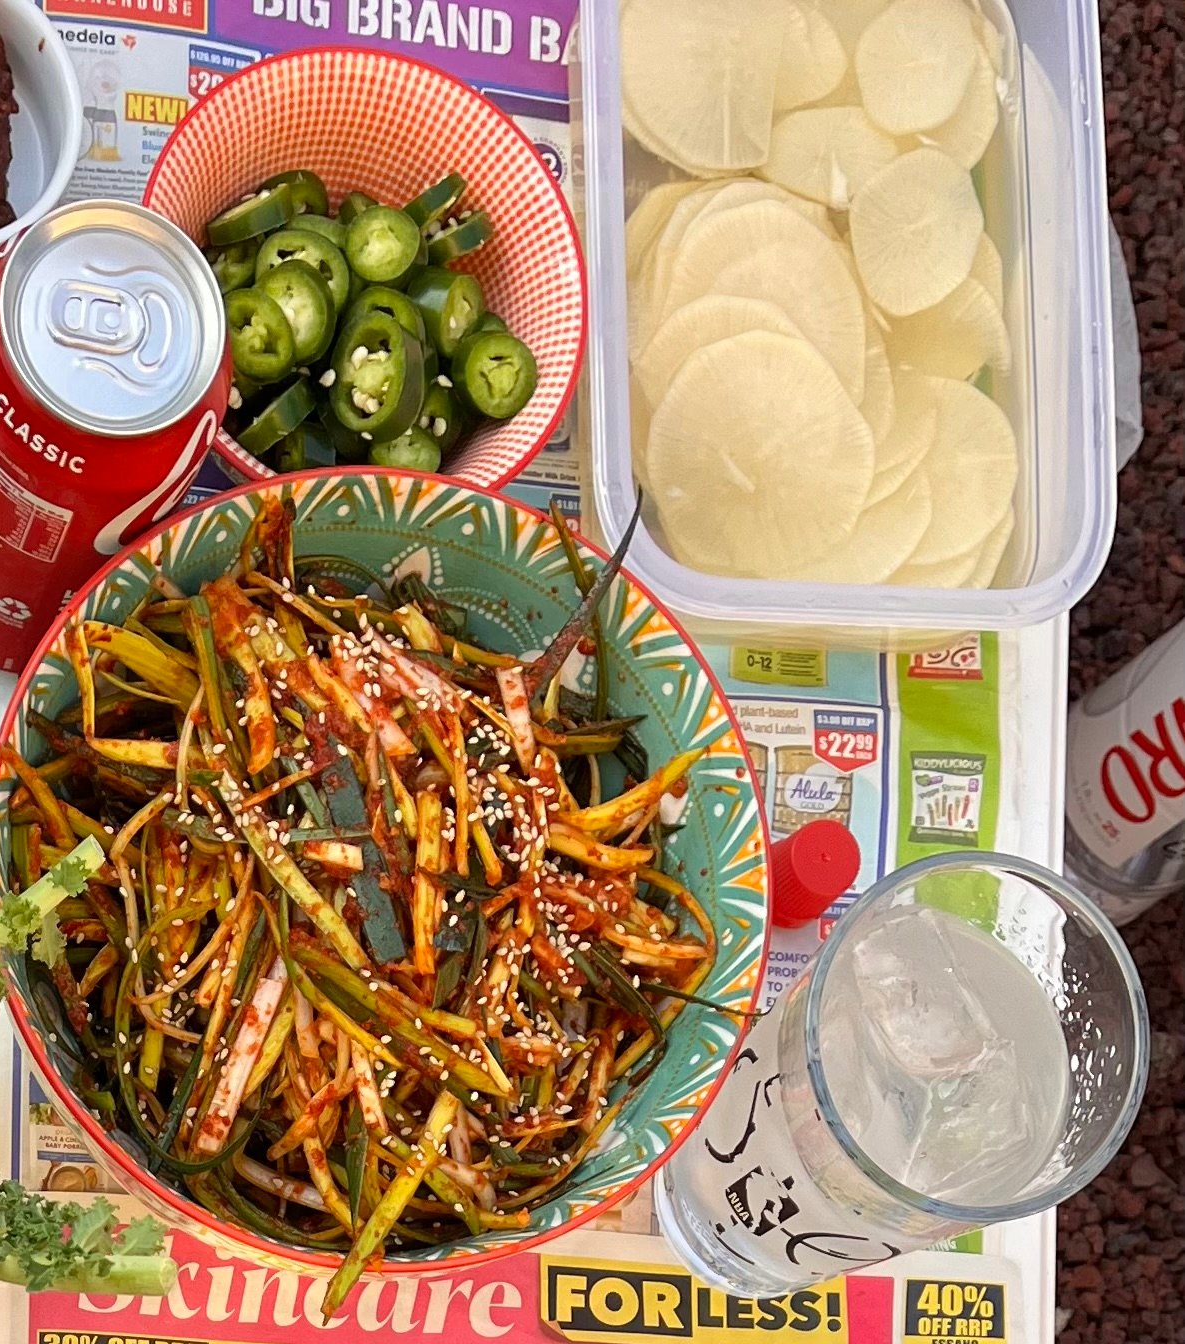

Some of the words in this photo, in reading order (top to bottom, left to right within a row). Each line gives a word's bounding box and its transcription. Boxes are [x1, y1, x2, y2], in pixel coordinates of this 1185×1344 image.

[347, 0, 513, 55] BRAND
[127, 94, 188, 125] NEW!
[747, 655, 772, 671] 0-12
[740, 707, 799, 721] plant-based
[756, 723, 772, 734] and
[768, 951, 812, 964] COMFO
[728, 1192, 750, 1222] NBA
[556, 1274, 684, 1329] FOR
[697, 1287, 843, 1333] LESS!
[917, 1284, 994, 1318] 40%
[918, 1318, 951, 1337] OFF
[955, 1319, 994, 1338] RRP
